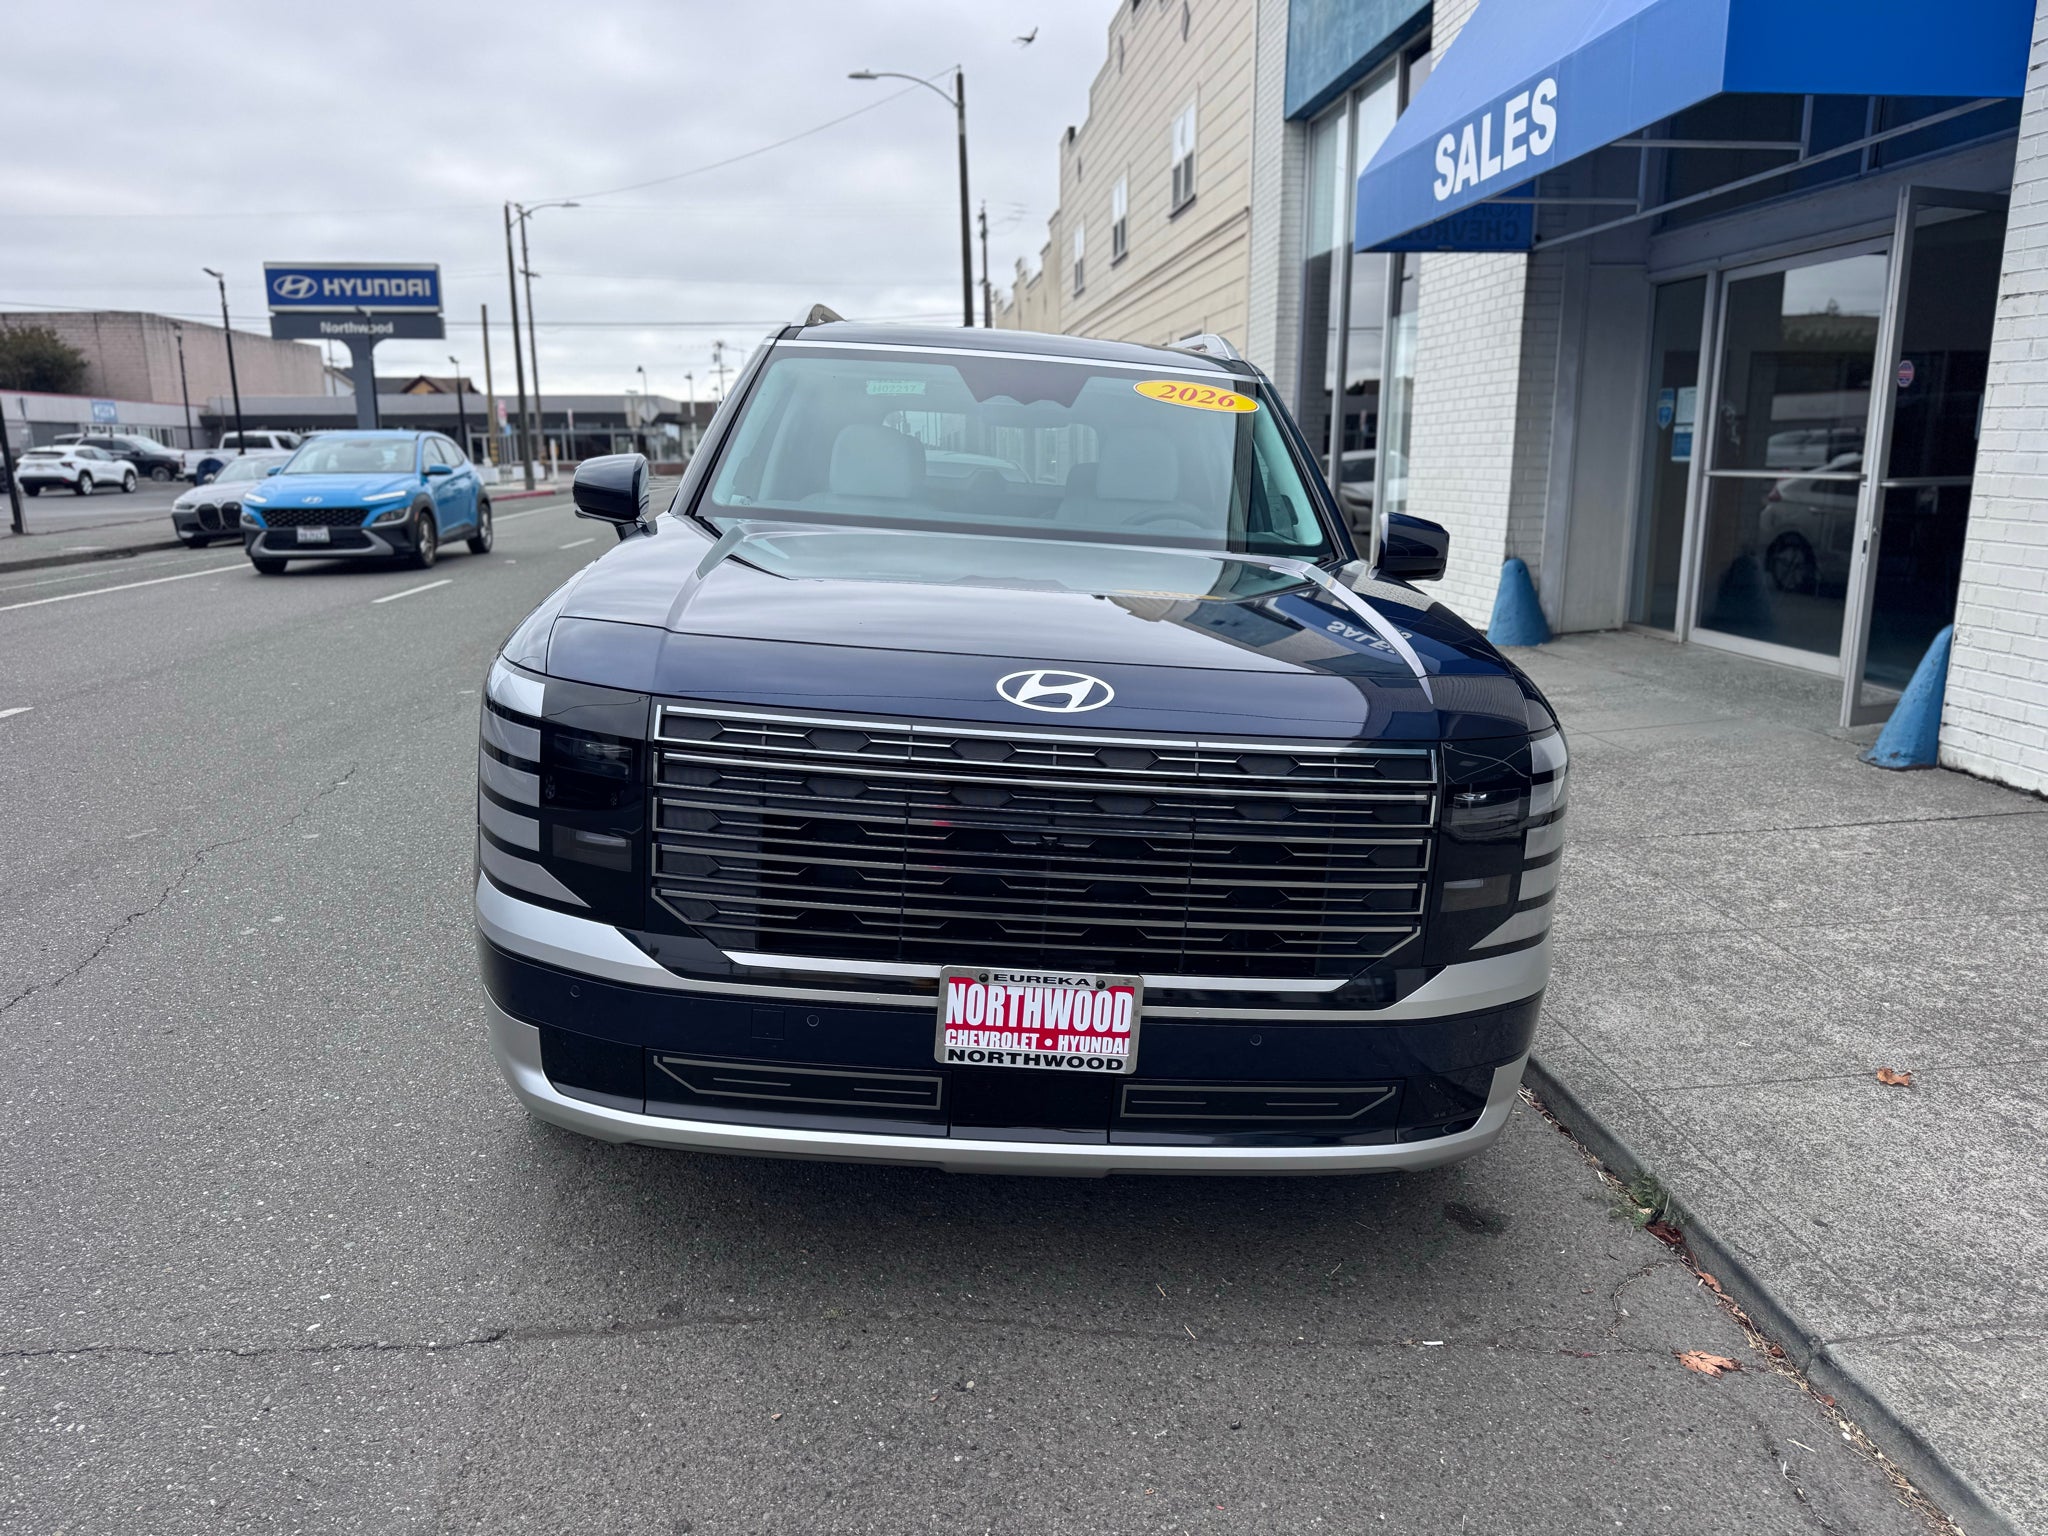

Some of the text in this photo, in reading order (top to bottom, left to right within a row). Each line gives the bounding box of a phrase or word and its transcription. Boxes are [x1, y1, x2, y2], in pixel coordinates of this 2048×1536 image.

[1433, 78, 1557, 201] SALES
[322, 278, 431, 297] HYUNDAI
[1158, 384, 1235, 407] 2026
[994, 973, 1091, 987] EUREKA
[945, 982, 1133, 1033] NORTHWOOD
[945, 1029, 1130, 1054] CHEVROLET HYUNDAI
[947, 1048, 1124, 1071] NORTHWOOD
